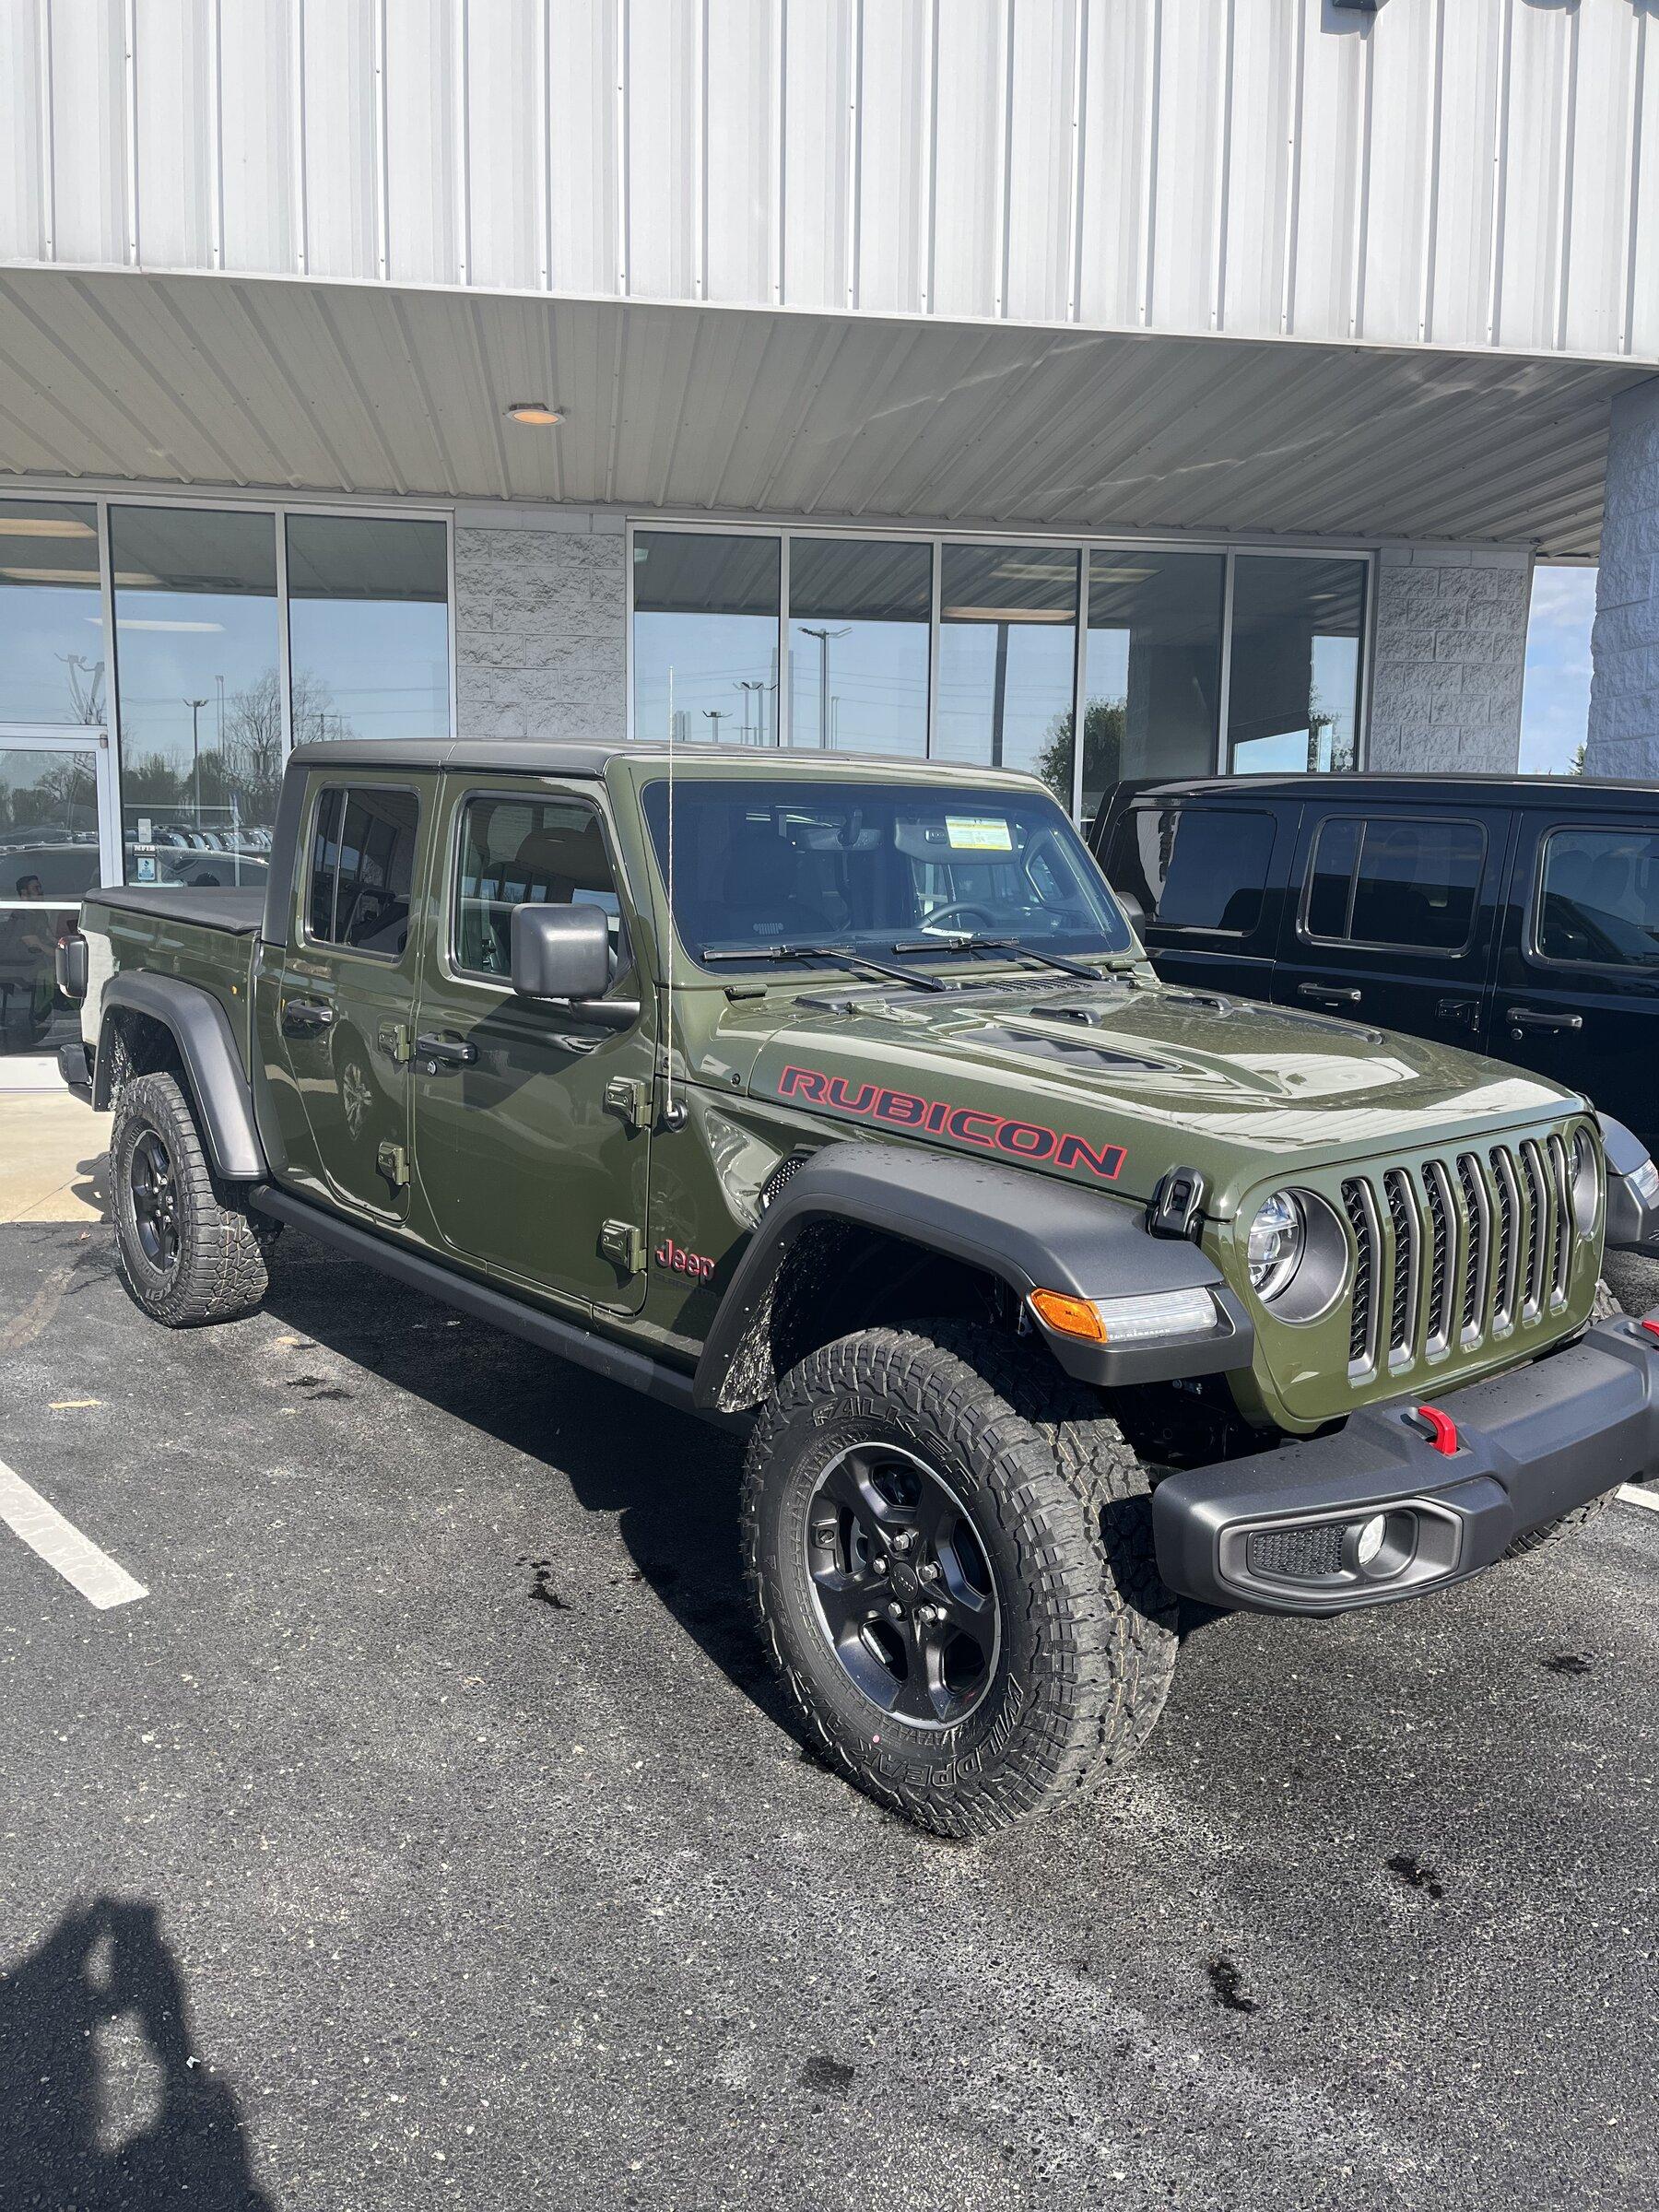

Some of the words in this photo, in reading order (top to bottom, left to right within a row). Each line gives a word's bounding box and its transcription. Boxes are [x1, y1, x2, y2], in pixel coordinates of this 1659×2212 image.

[777, 1065, 1128, 1181] RUBICON
[654, 1239, 714, 1283] Jeep
[812, 1395, 979, 1496] FALKEN
[851, 1672, 1024, 1787] WILDPEAK
